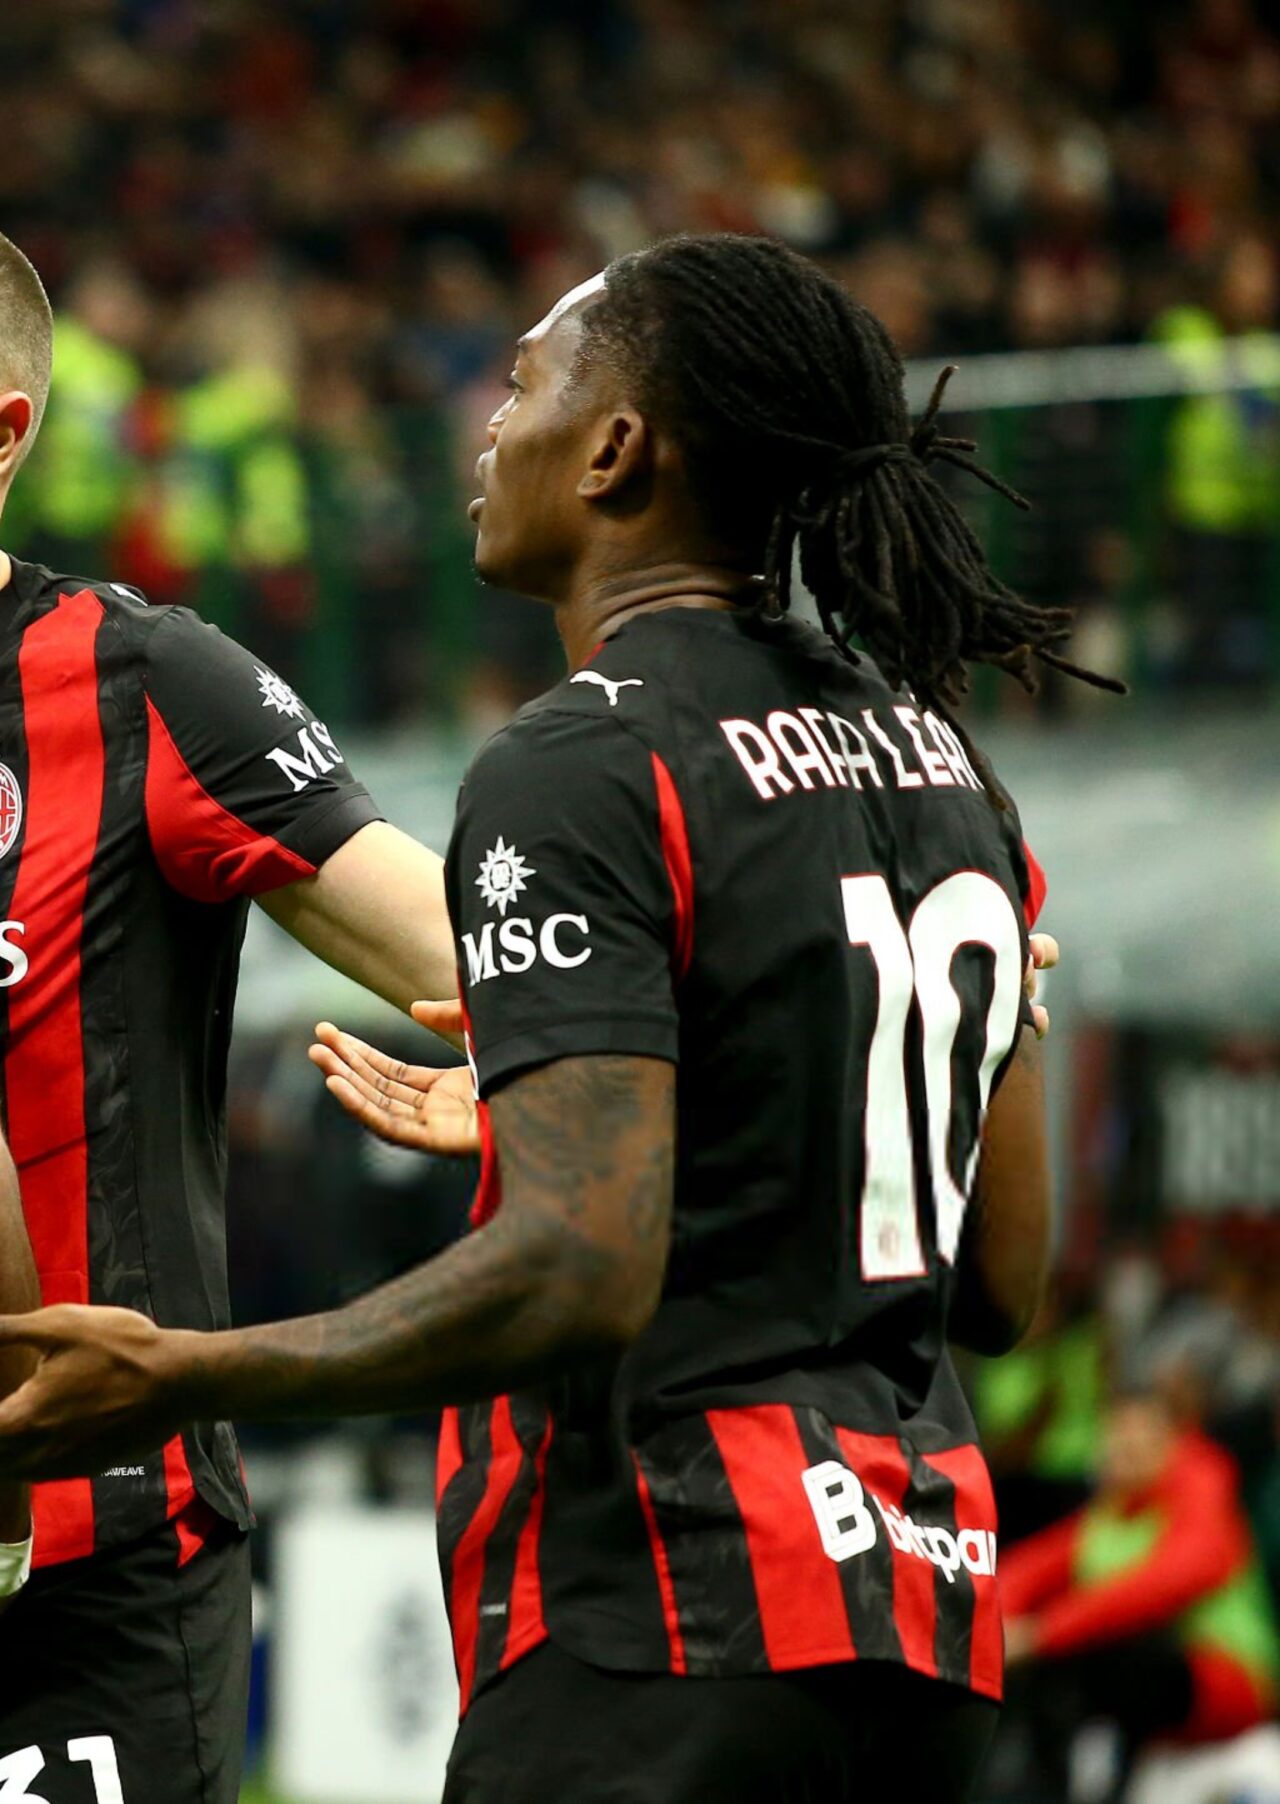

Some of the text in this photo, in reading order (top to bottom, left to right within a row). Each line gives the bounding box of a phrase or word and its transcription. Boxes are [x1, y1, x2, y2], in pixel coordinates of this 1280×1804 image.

[719, 706, 884, 800] RAFA
[461, 913, 592, 987] MSC
[840, 868, 1021, 1281] 10
[872, 1494, 997, 1584] bitpa
